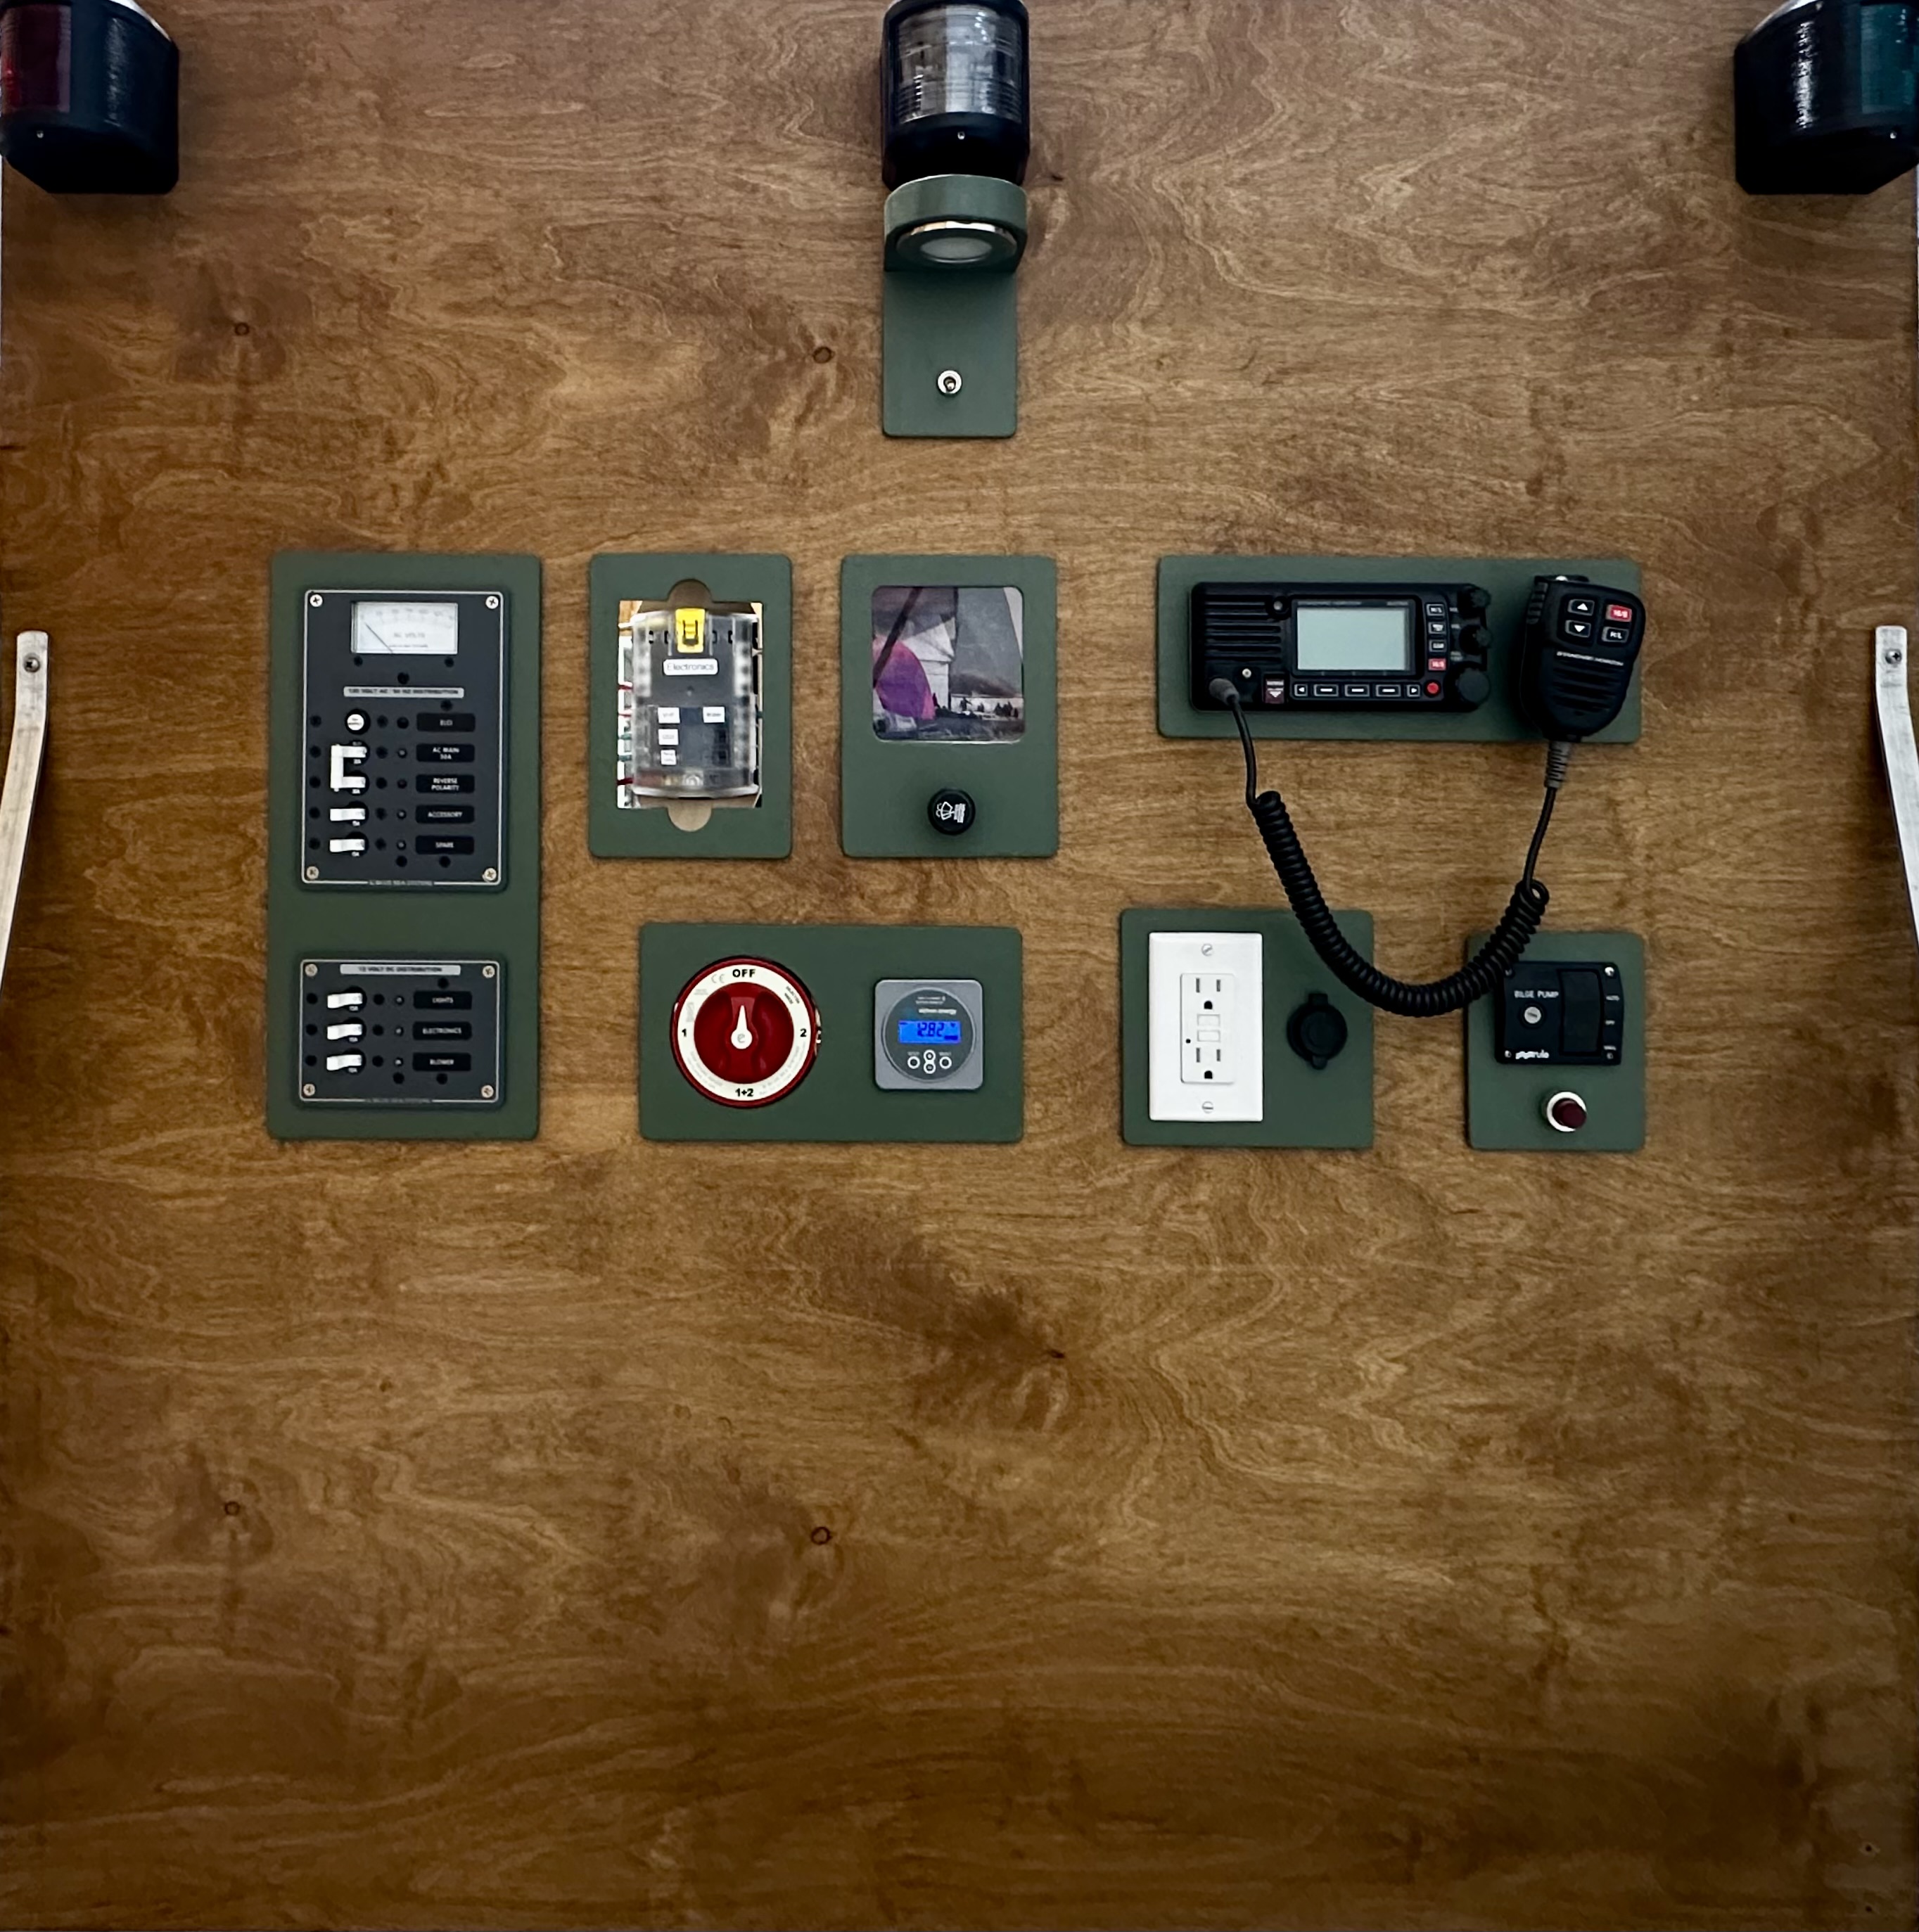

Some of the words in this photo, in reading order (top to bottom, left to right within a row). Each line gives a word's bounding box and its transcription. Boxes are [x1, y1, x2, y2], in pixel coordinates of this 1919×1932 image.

[667, 663, 715, 671] Electronics
[732, 968, 756, 978] OFF
[681, 1028, 687, 1037] 1
[799, 1028, 808, 1038] 2
[734, 1087, 754, 1098] 1+2
